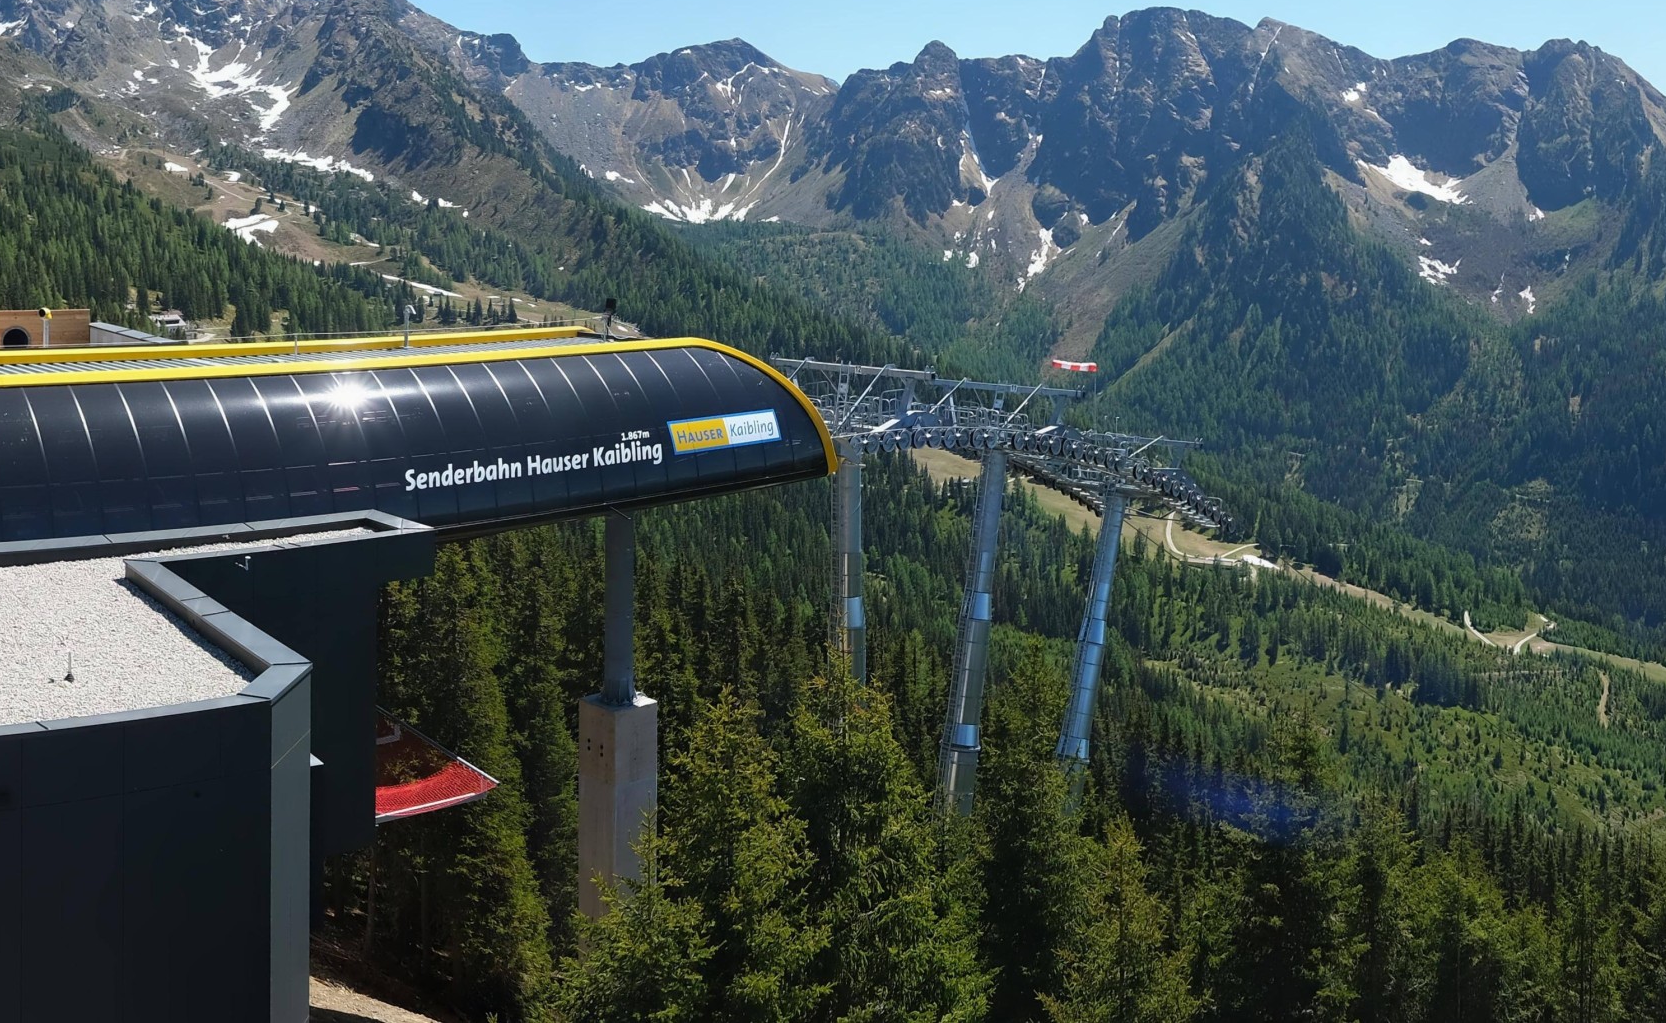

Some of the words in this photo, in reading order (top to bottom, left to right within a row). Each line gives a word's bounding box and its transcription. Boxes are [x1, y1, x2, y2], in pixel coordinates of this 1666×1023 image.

[621, 430, 650, 442] 1.867m
[676, 428, 724, 444] HAUSER
[729, 420, 774, 437] Kaibling
[405, 457, 522, 491] Senderbahn
[527, 451, 590, 476] Hauser
[592, 441, 663, 466] Kaibling
